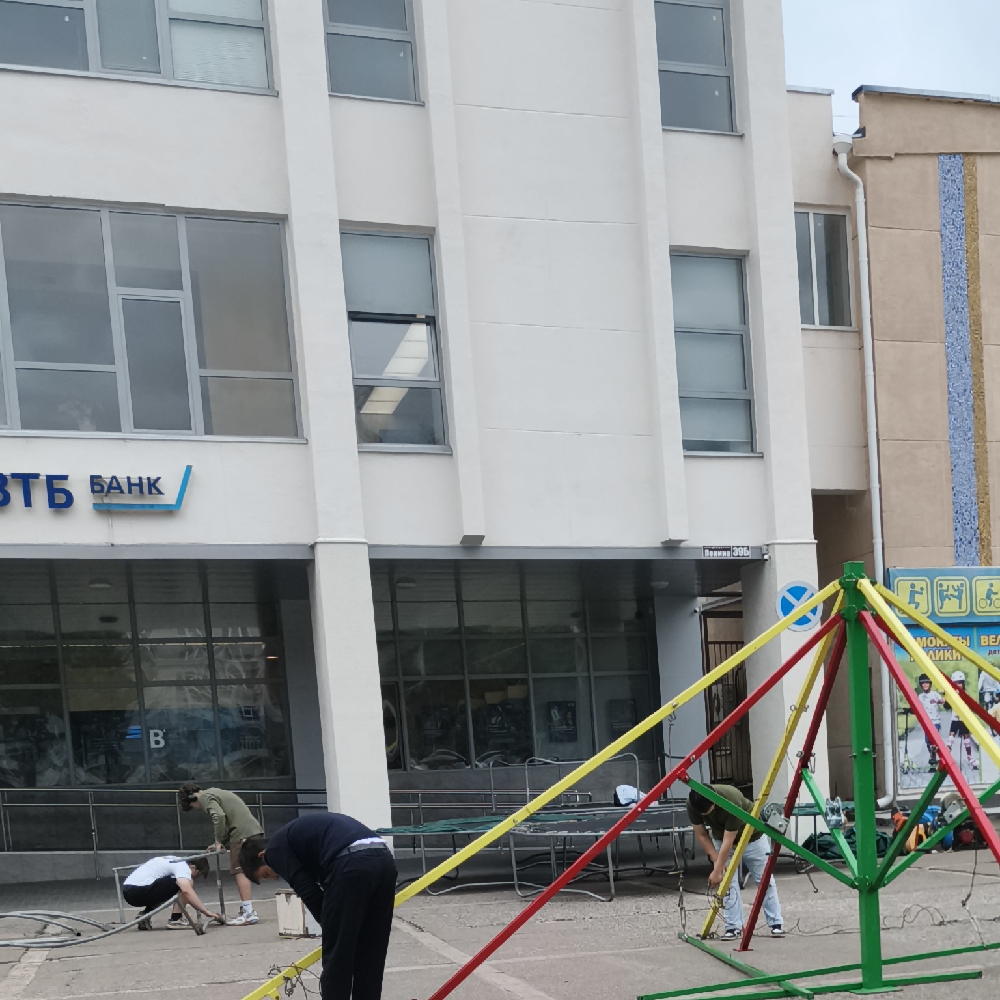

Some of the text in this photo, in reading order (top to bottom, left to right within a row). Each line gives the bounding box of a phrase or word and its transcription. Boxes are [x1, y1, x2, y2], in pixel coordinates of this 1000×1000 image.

[90, 474, 165, 496] БАНК
[914, 635, 971, 649] МОКЫ
[910, 648, 962, 662] ЛИКИ
